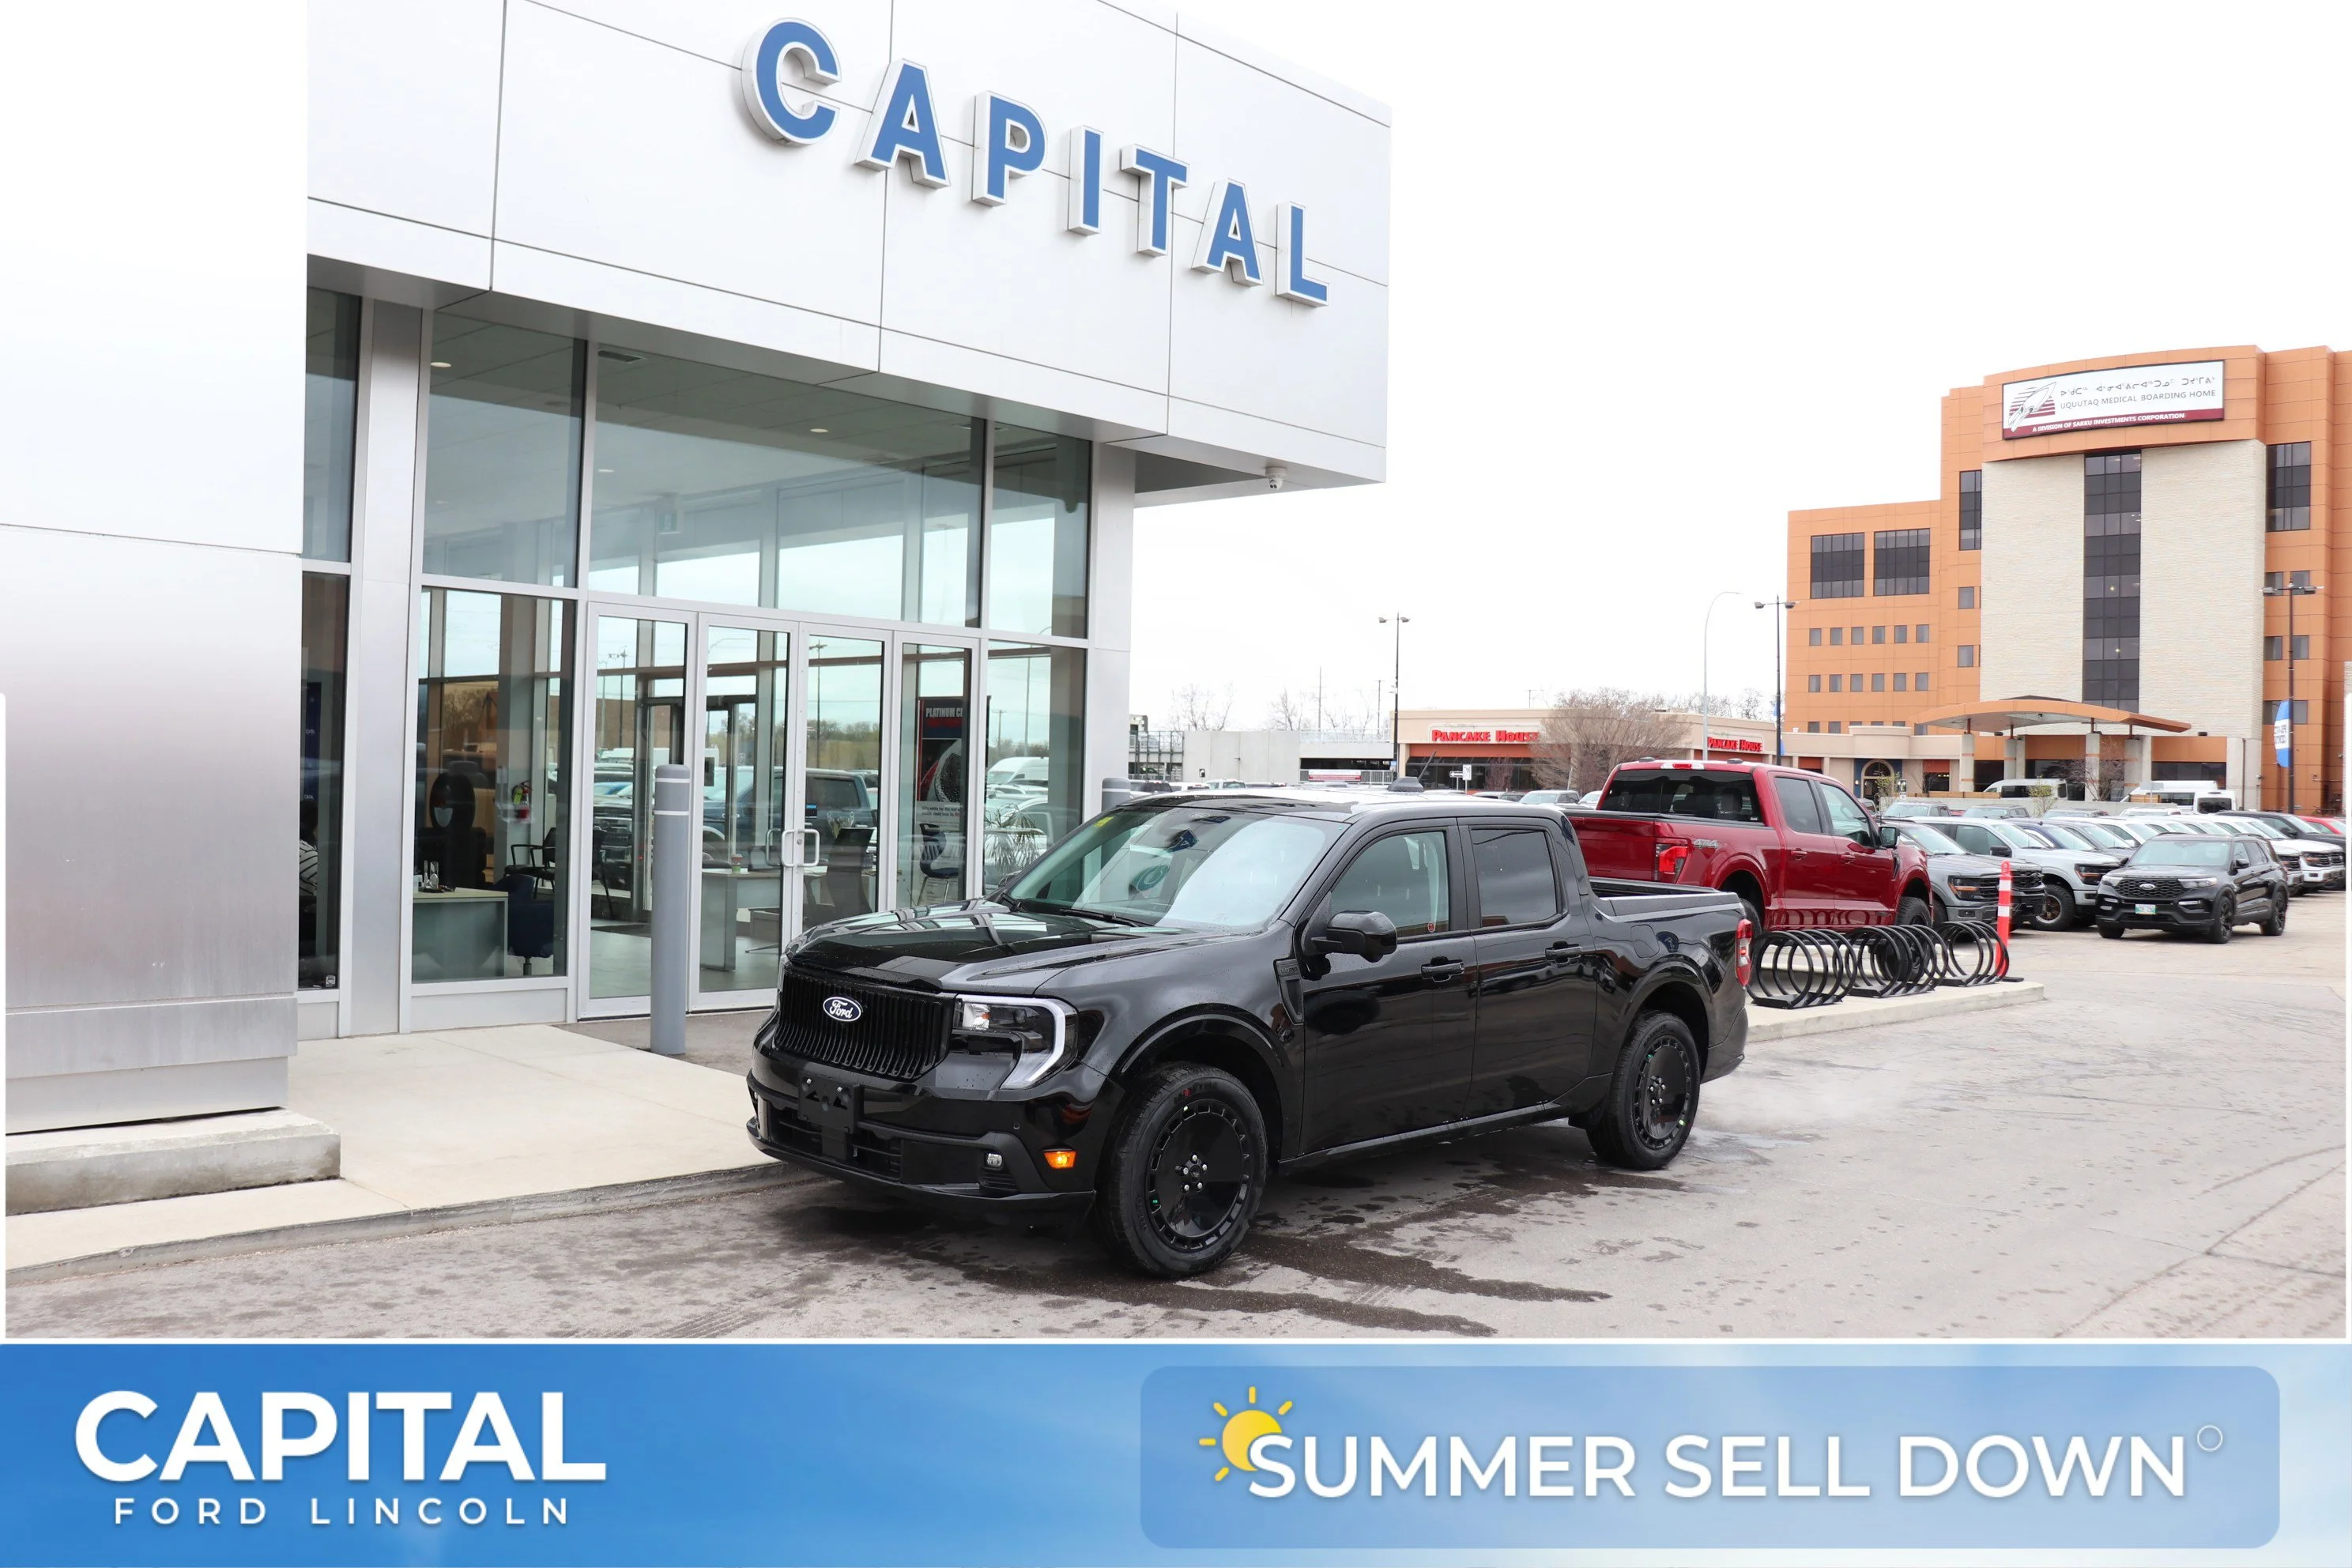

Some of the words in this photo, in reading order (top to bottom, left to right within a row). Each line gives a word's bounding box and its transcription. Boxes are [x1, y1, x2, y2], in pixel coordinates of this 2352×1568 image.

[749, 19, 1329, 307] CAPITAL
[2060, 398, 2100, 409] UQUUTAQ
[2101, 395, 2137, 405] MEDICAL
[2141, 391, 2187, 401] BOARDING
[2037, 424, 2063, 432] DIVISION
[2072, 419, 2093, 428] SAKKU
[2094, 416, 2137, 425] INVESTMENTS
[2137, 413, 2185, 421] CORPORATION
[925, 707, 956, 718] PLATINUM
[1432, 729, 1491, 742] PANCAKE
[1495, 729, 1540, 742] HOUSE
[1707, 736, 1739, 750] PANCAKE
[1740, 739, 1762, 752] HOUSE
[830, 999, 854, 1019] Ford
